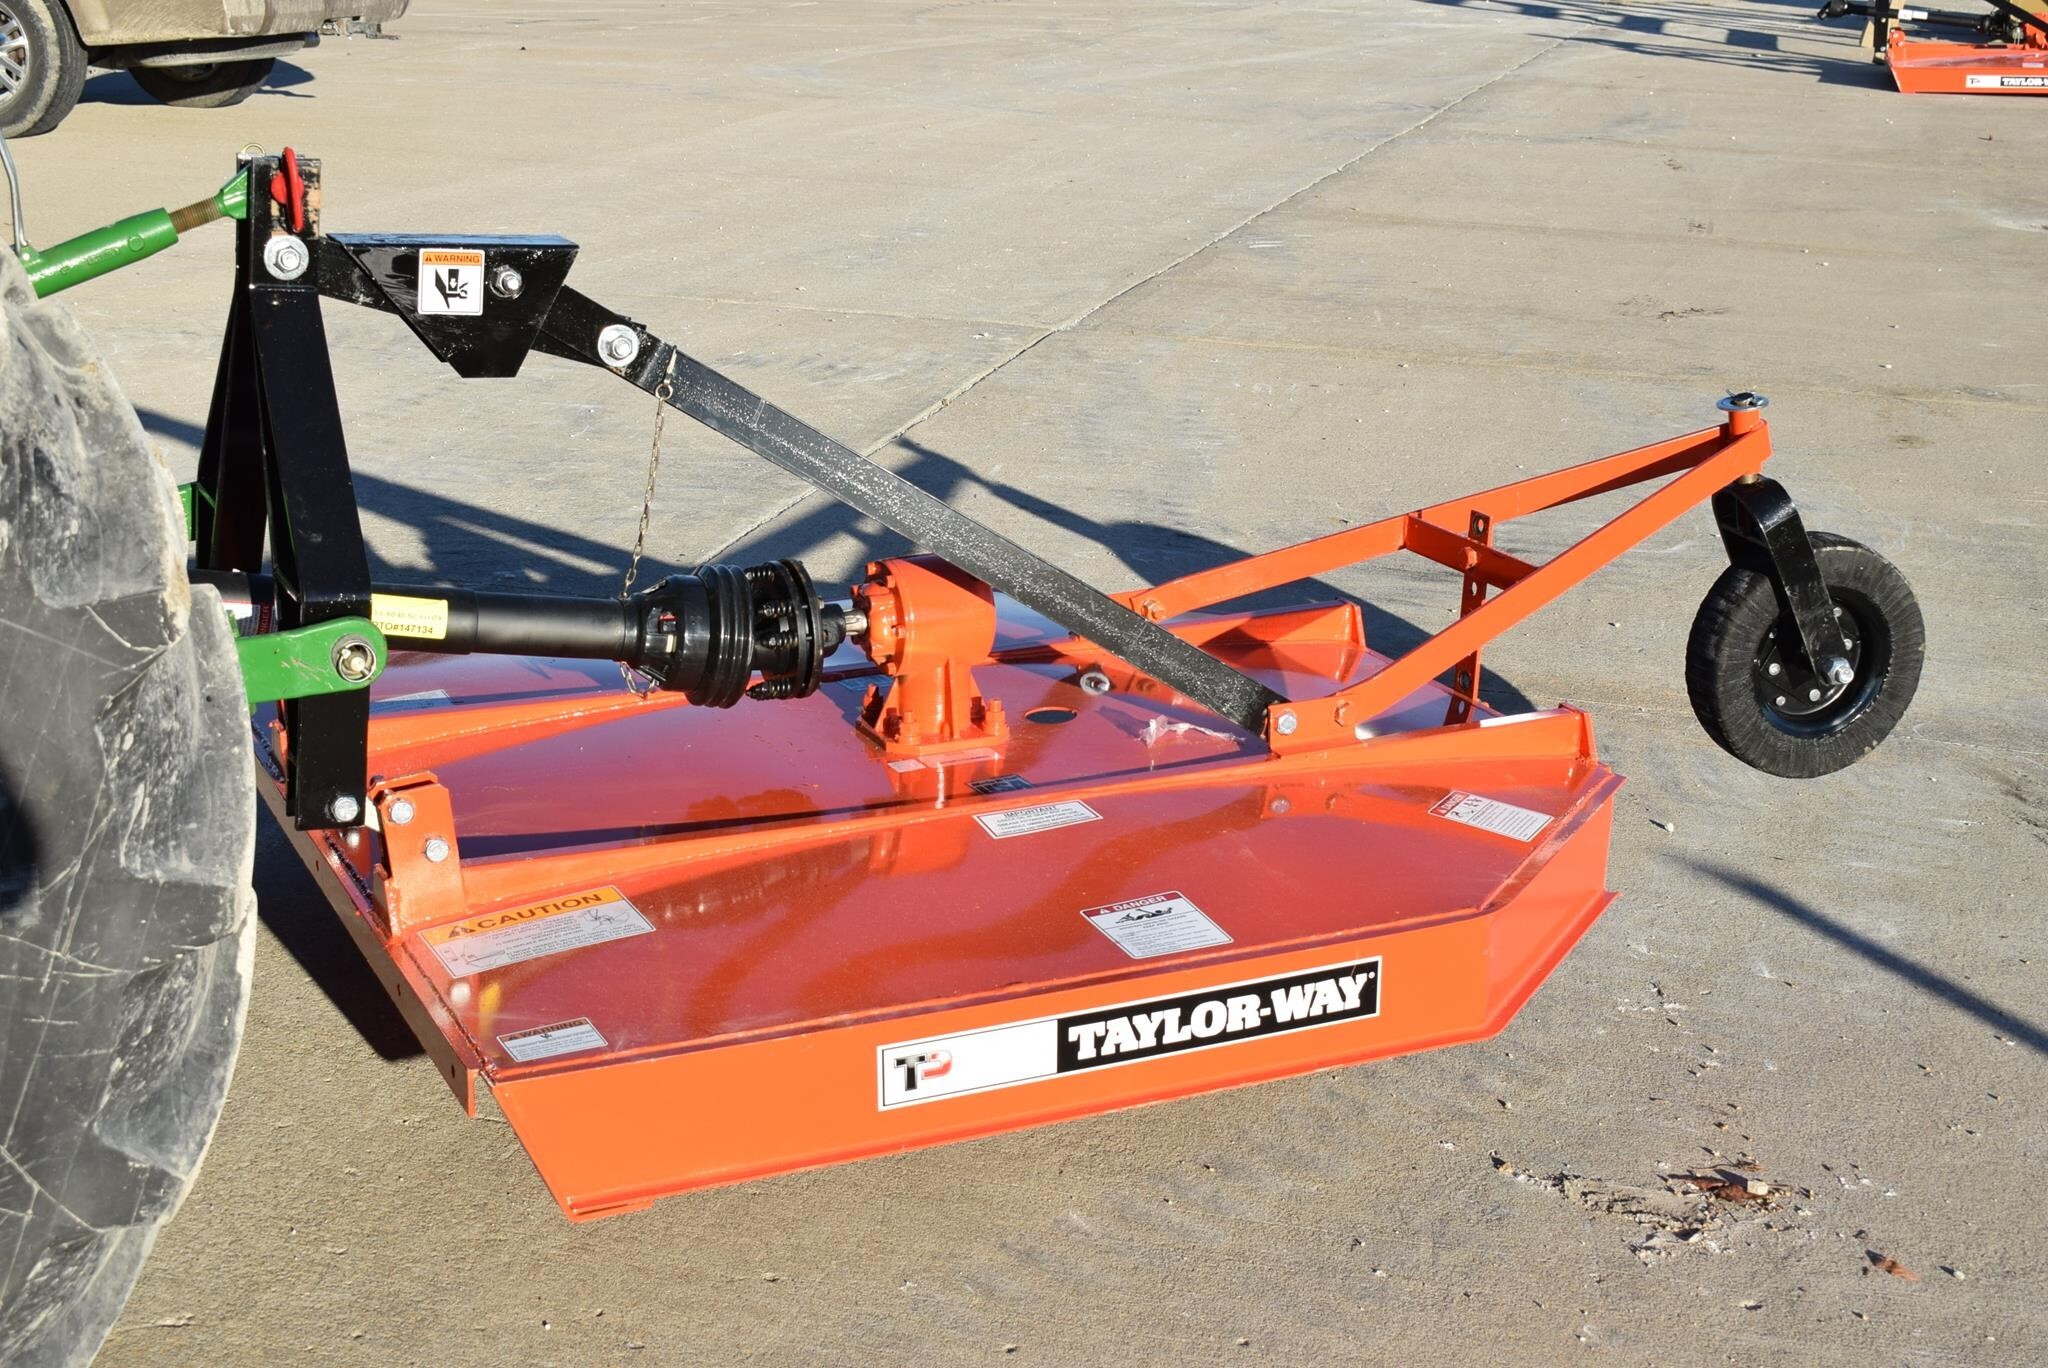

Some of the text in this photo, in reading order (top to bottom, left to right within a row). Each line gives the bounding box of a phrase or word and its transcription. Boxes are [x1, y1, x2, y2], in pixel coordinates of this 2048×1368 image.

[434, 254, 480, 263] WARNING
[477, 894, 602, 929] CAUTION
[1113, 895, 1167, 911] DANGER
[1068, 972, 1368, 1061] TAYLOR-WAY
[519, 1020, 583, 1038] WARNING
